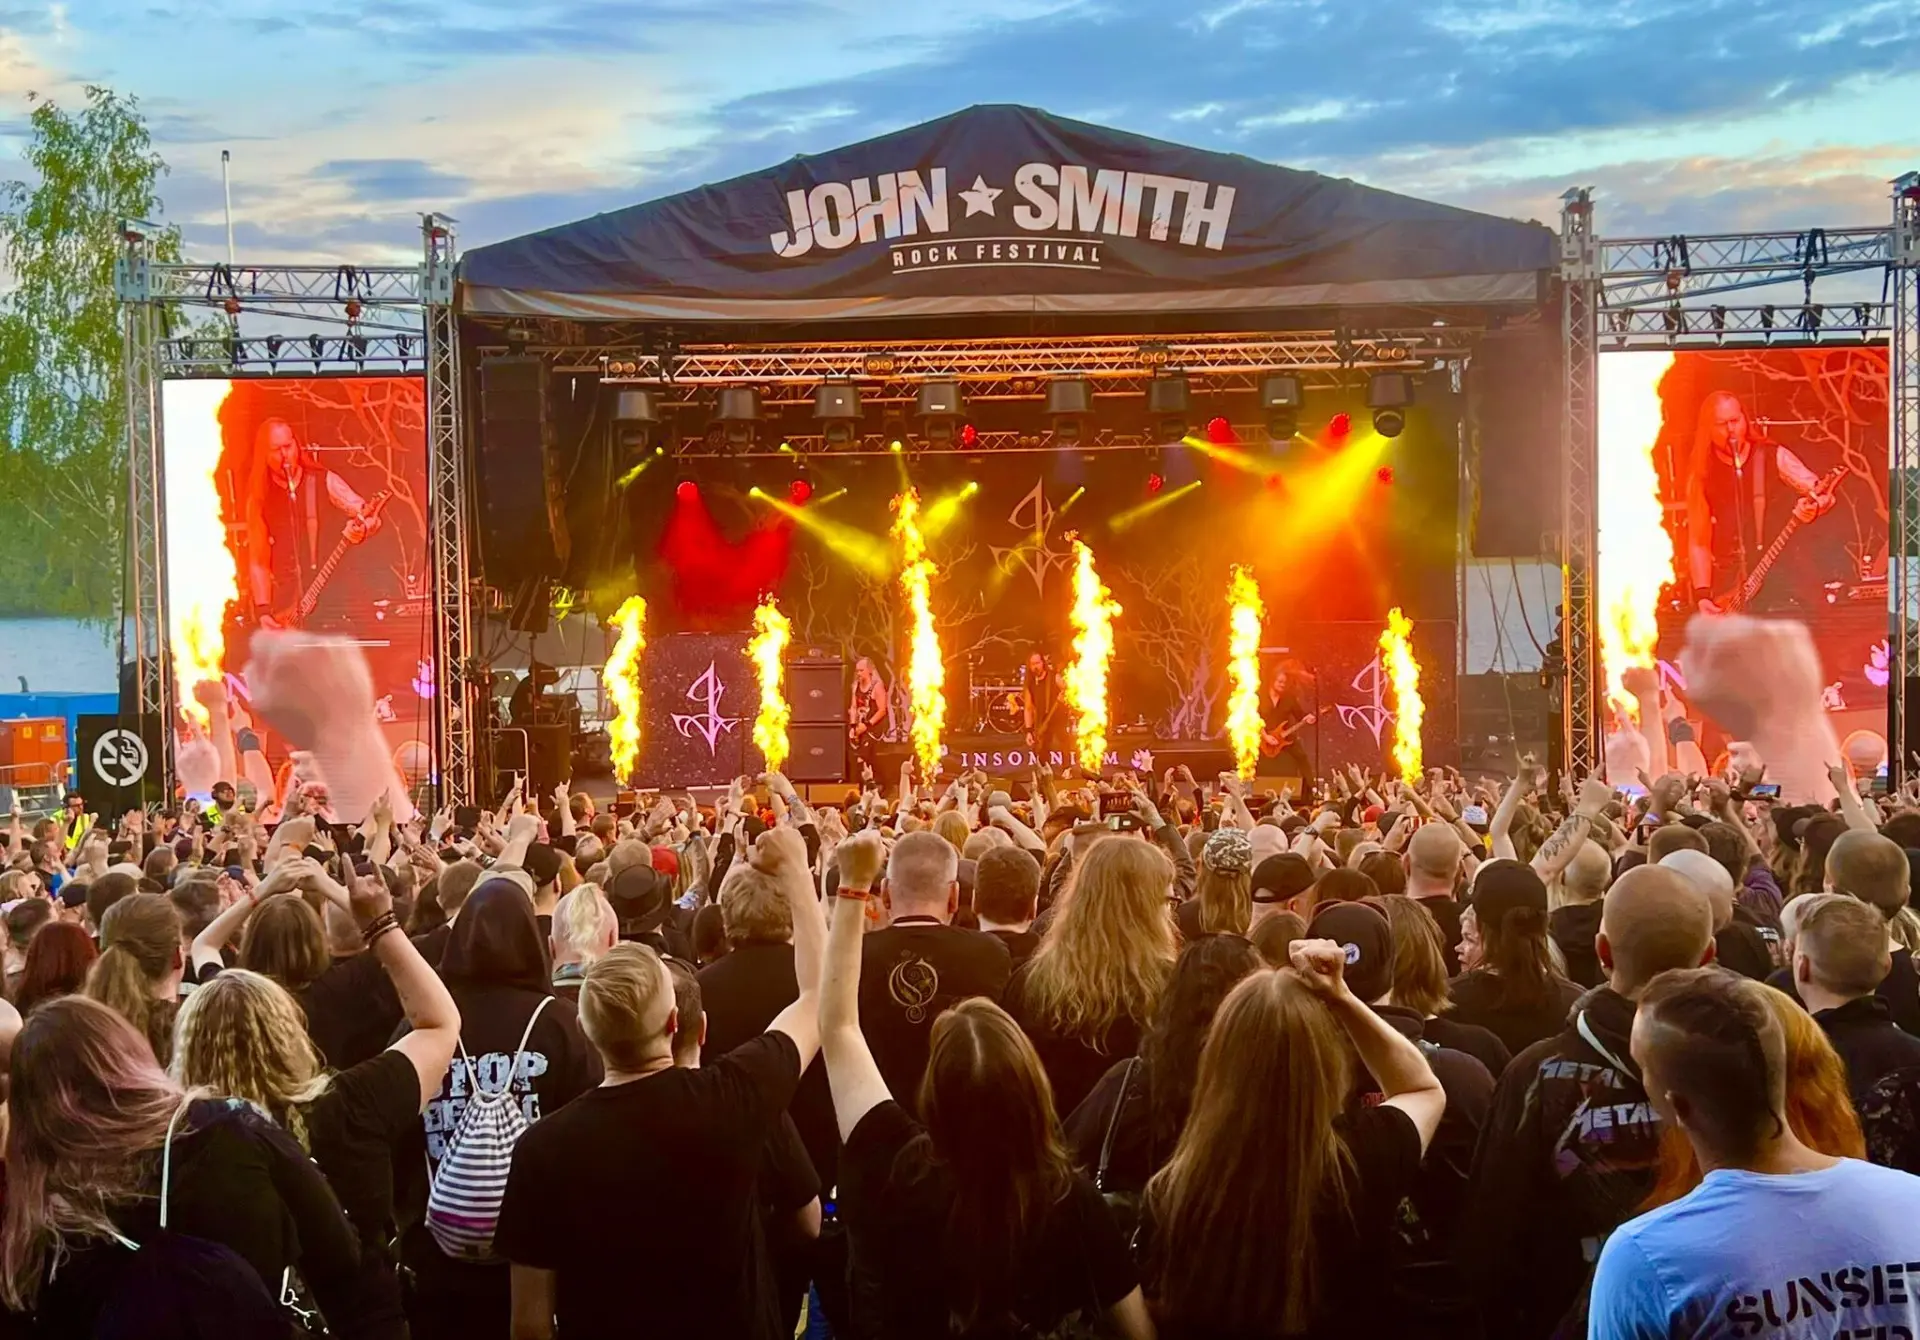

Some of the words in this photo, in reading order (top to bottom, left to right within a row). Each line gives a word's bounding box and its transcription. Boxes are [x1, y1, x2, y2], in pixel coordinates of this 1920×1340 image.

[770, 167, 949, 258] JOHN
[1013, 163, 1236, 251] SMITH
[892, 244, 959, 267] ROCK
[976, 243, 1101, 264] FESTIVAL
[960, 751, 1119, 767] INSOMNIM
[436, 1051, 549, 1098] TOP
[423, 1093, 541, 1132] BEG
